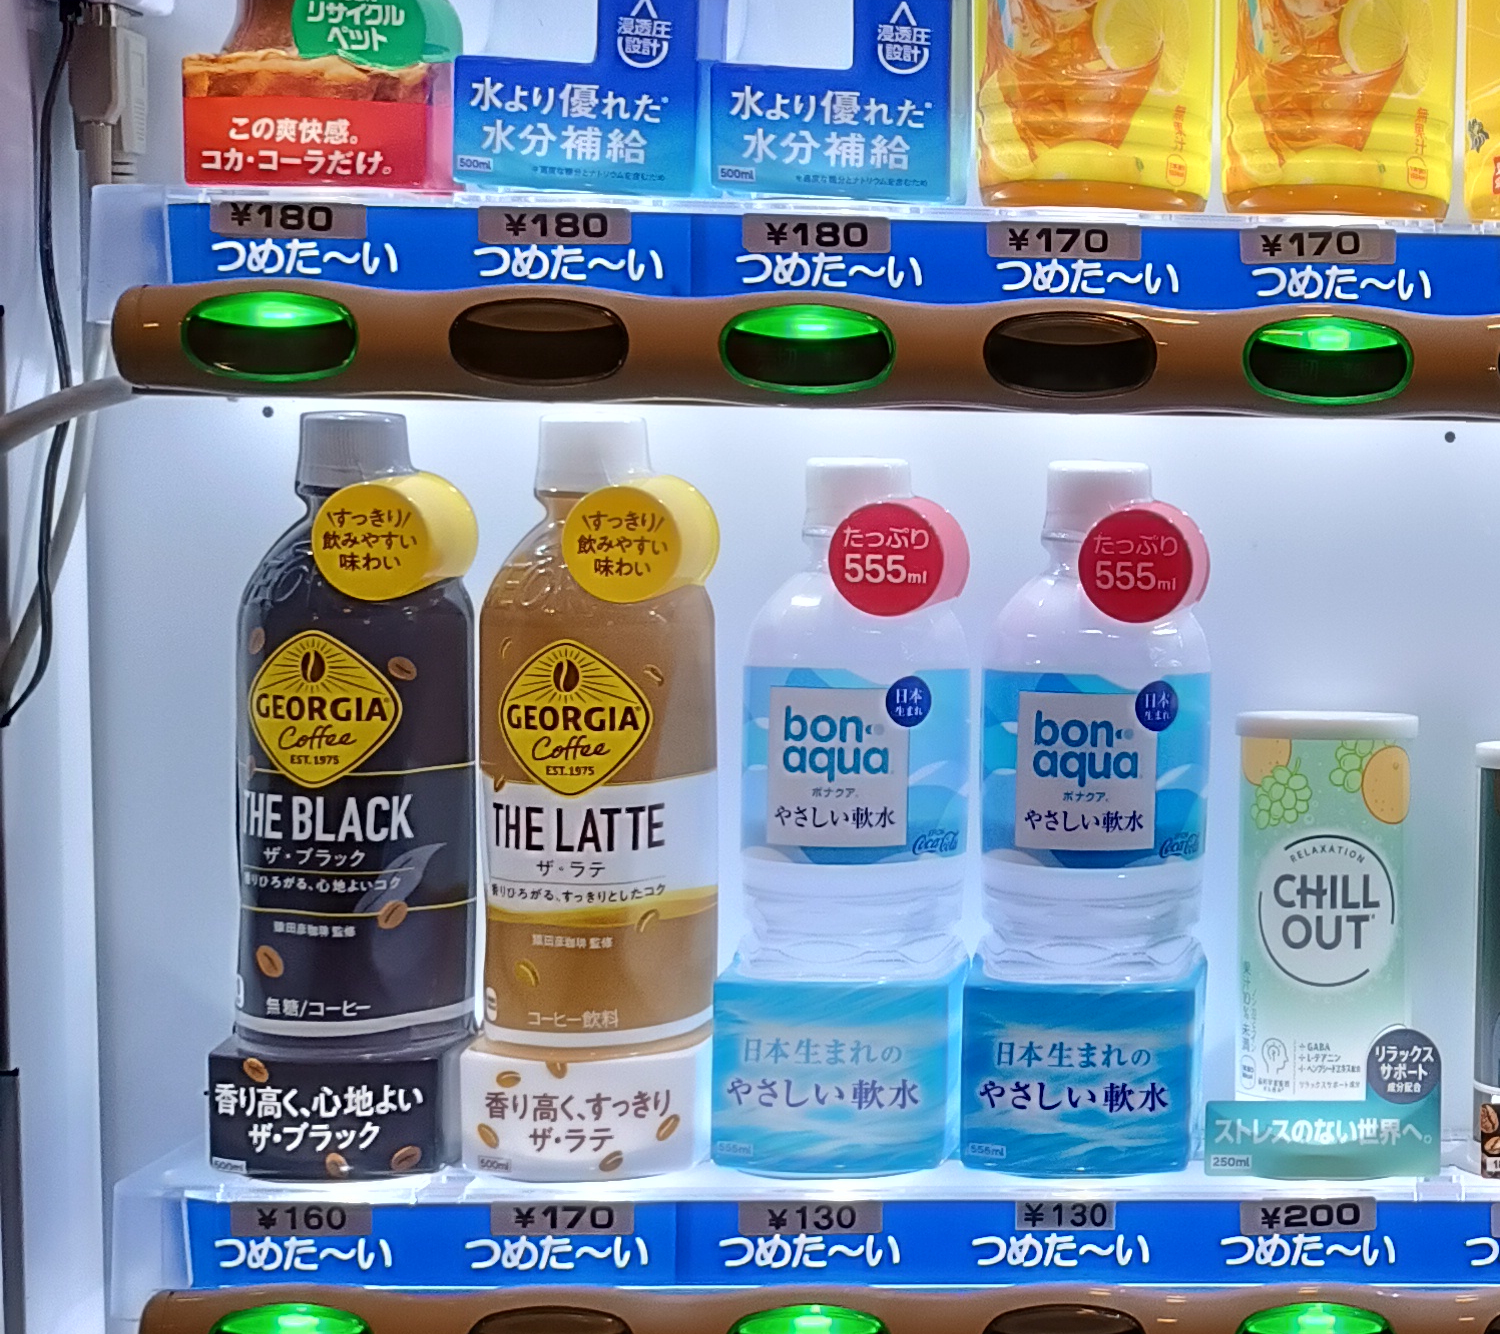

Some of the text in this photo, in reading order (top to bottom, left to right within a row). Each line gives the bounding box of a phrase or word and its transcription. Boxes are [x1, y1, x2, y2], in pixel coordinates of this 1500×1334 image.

[306, 1, 405, 29] リサイクル
[617, 17, 673, 37] 浸透圧
[327, 27, 388, 52] ペット
[469, 78, 662, 124] 水より優れた
[228, 117, 360, 146] この爽快感。
[482, 119, 648, 165] 水分補給
[200, 148, 393, 176] コカ・コーラだけ。
[230, 204, 333, 232] ¥180
[505, 212, 608, 238] ¥180
[766, 222, 868, 247] ¥180
[1008, 227, 1109, 253] ¥170
[1262, 230, 1361, 256] ¥170
[339, 553, 401, 572] 味わい
[895, 687, 923, 705] 日本
[783, 746, 890, 782] aqua
[292, 793, 414, 843] BLACK
[492, 802, 665, 853] THE LATTE
[1290, 844, 1365, 864] RELAXATION
[1273, 872, 1380, 910] CHILL
[1282, 914, 1371, 951] OUT
[743, 1036, 903, 1066] 日本生まれの
[1375, 1044, 1435, 1062] リラックス
[1379, 1064, 1429, 1080] サポート
[214, 1083, 424, 1118] 香り高く、心地よい
[485, 1089, 672, 1120] 香り高く、すっきり
[726, 1076, 920, 1110] やさしい軟水
[1214, 1117, 1433, 1146] ストレスのない世界へ。
[1213, 1155, 1250, 1168] 250ml
[257, 1205, 346, 1230] ¥160
[515, 1204, 614, 1230] ¥170
[768, 1204, 857, 1231] ¥130
[1024, 1202, 1108, 1227] ¥130
[1260, 1203, 1361, 1228] ¥200
